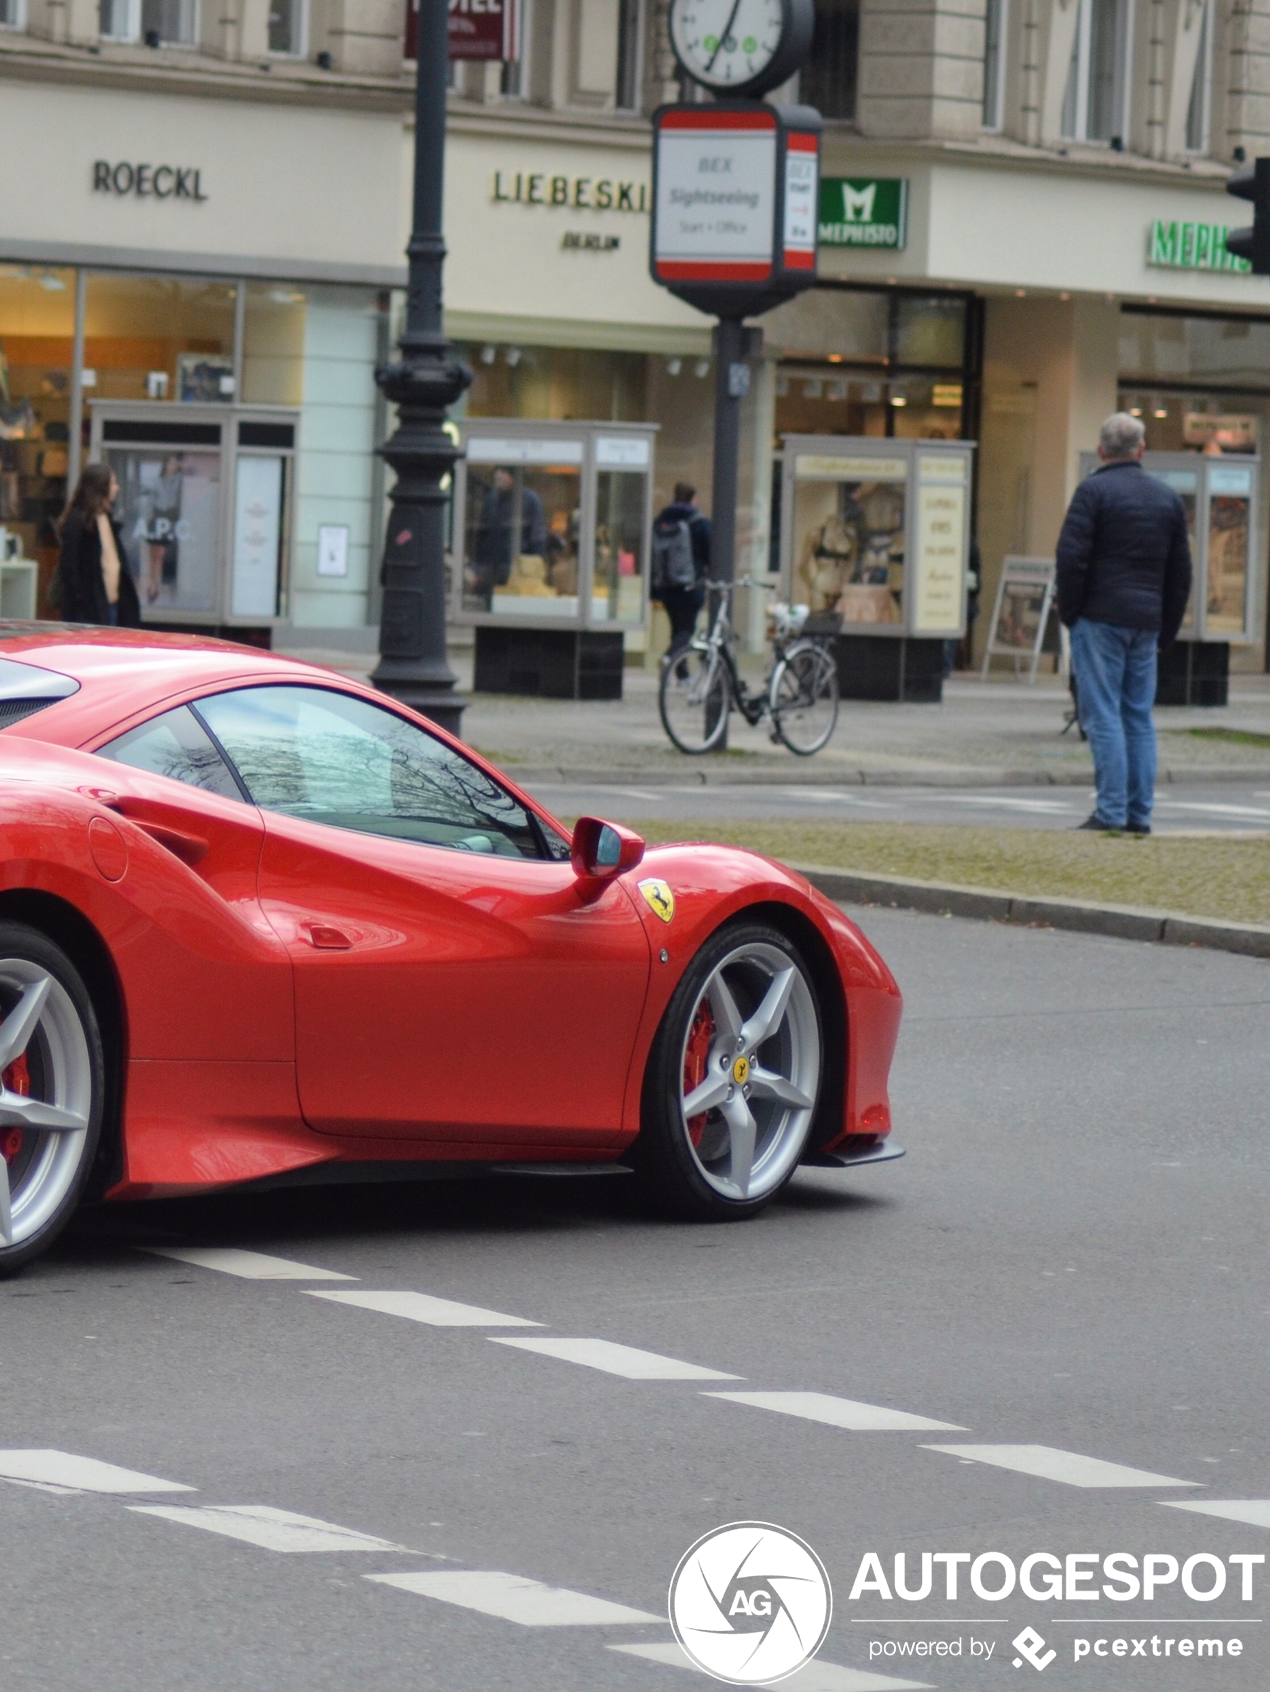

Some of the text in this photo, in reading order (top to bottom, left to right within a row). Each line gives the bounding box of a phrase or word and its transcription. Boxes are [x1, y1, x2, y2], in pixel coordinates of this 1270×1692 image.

[698, 157, 732, 173] BEX
[93, 160, 209, 201] ROECKL
[669, 187, 760, 209] Sightseeing
[818, 222, 897, 244] MEPHISTO
